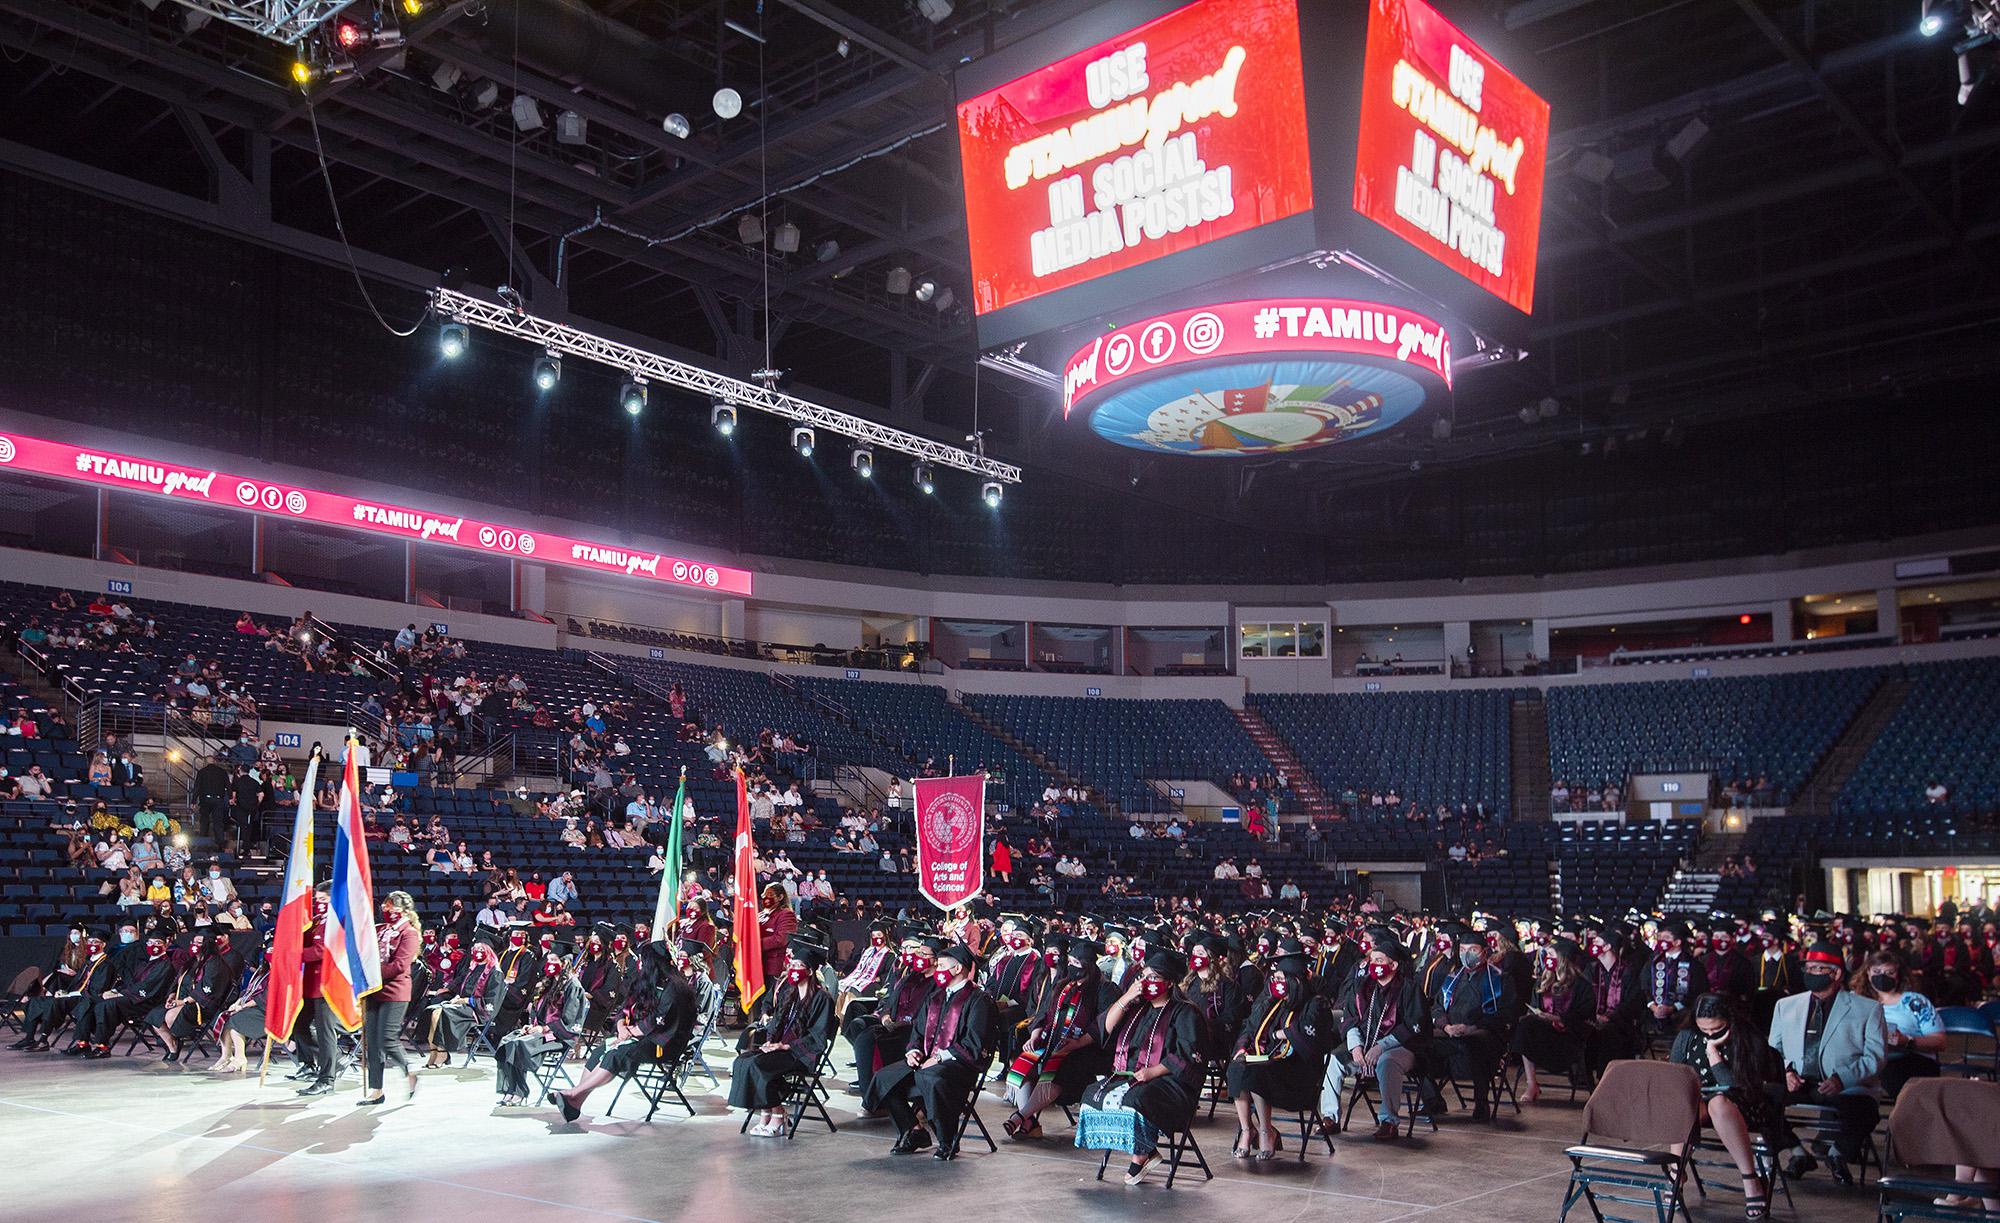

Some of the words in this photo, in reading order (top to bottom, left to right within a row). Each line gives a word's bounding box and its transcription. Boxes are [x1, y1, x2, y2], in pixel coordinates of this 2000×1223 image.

[1086, 42, 1149, 109] USE
[1448, 43, 1485, 113] USE
[1048, 174, 1085, 227] IN
[1093, 132, 1206, 212] SOCIAL
[1412, 128, 1436, 187] IN
[1438, 148, 1496, 227] SOCIAL
[1394, 164, 1450, 244] MEDIA
[1031, 208, 1124, 277] MEDIA
[1122, 165, 1234, 247] POSTS!
[110, 581, 130, 593] 104
[847, 671, 859, 679] 107
[278, 734, 299, 747] 104
[1663, 782, 1679, 792] 110
[931, 861, 958, 872] College
[959, 860, 968, 870] of
[933, 872, 948, 881] Arts
[949, 871, 965, 881] and
[933, 882, 965, 891] Sciences
